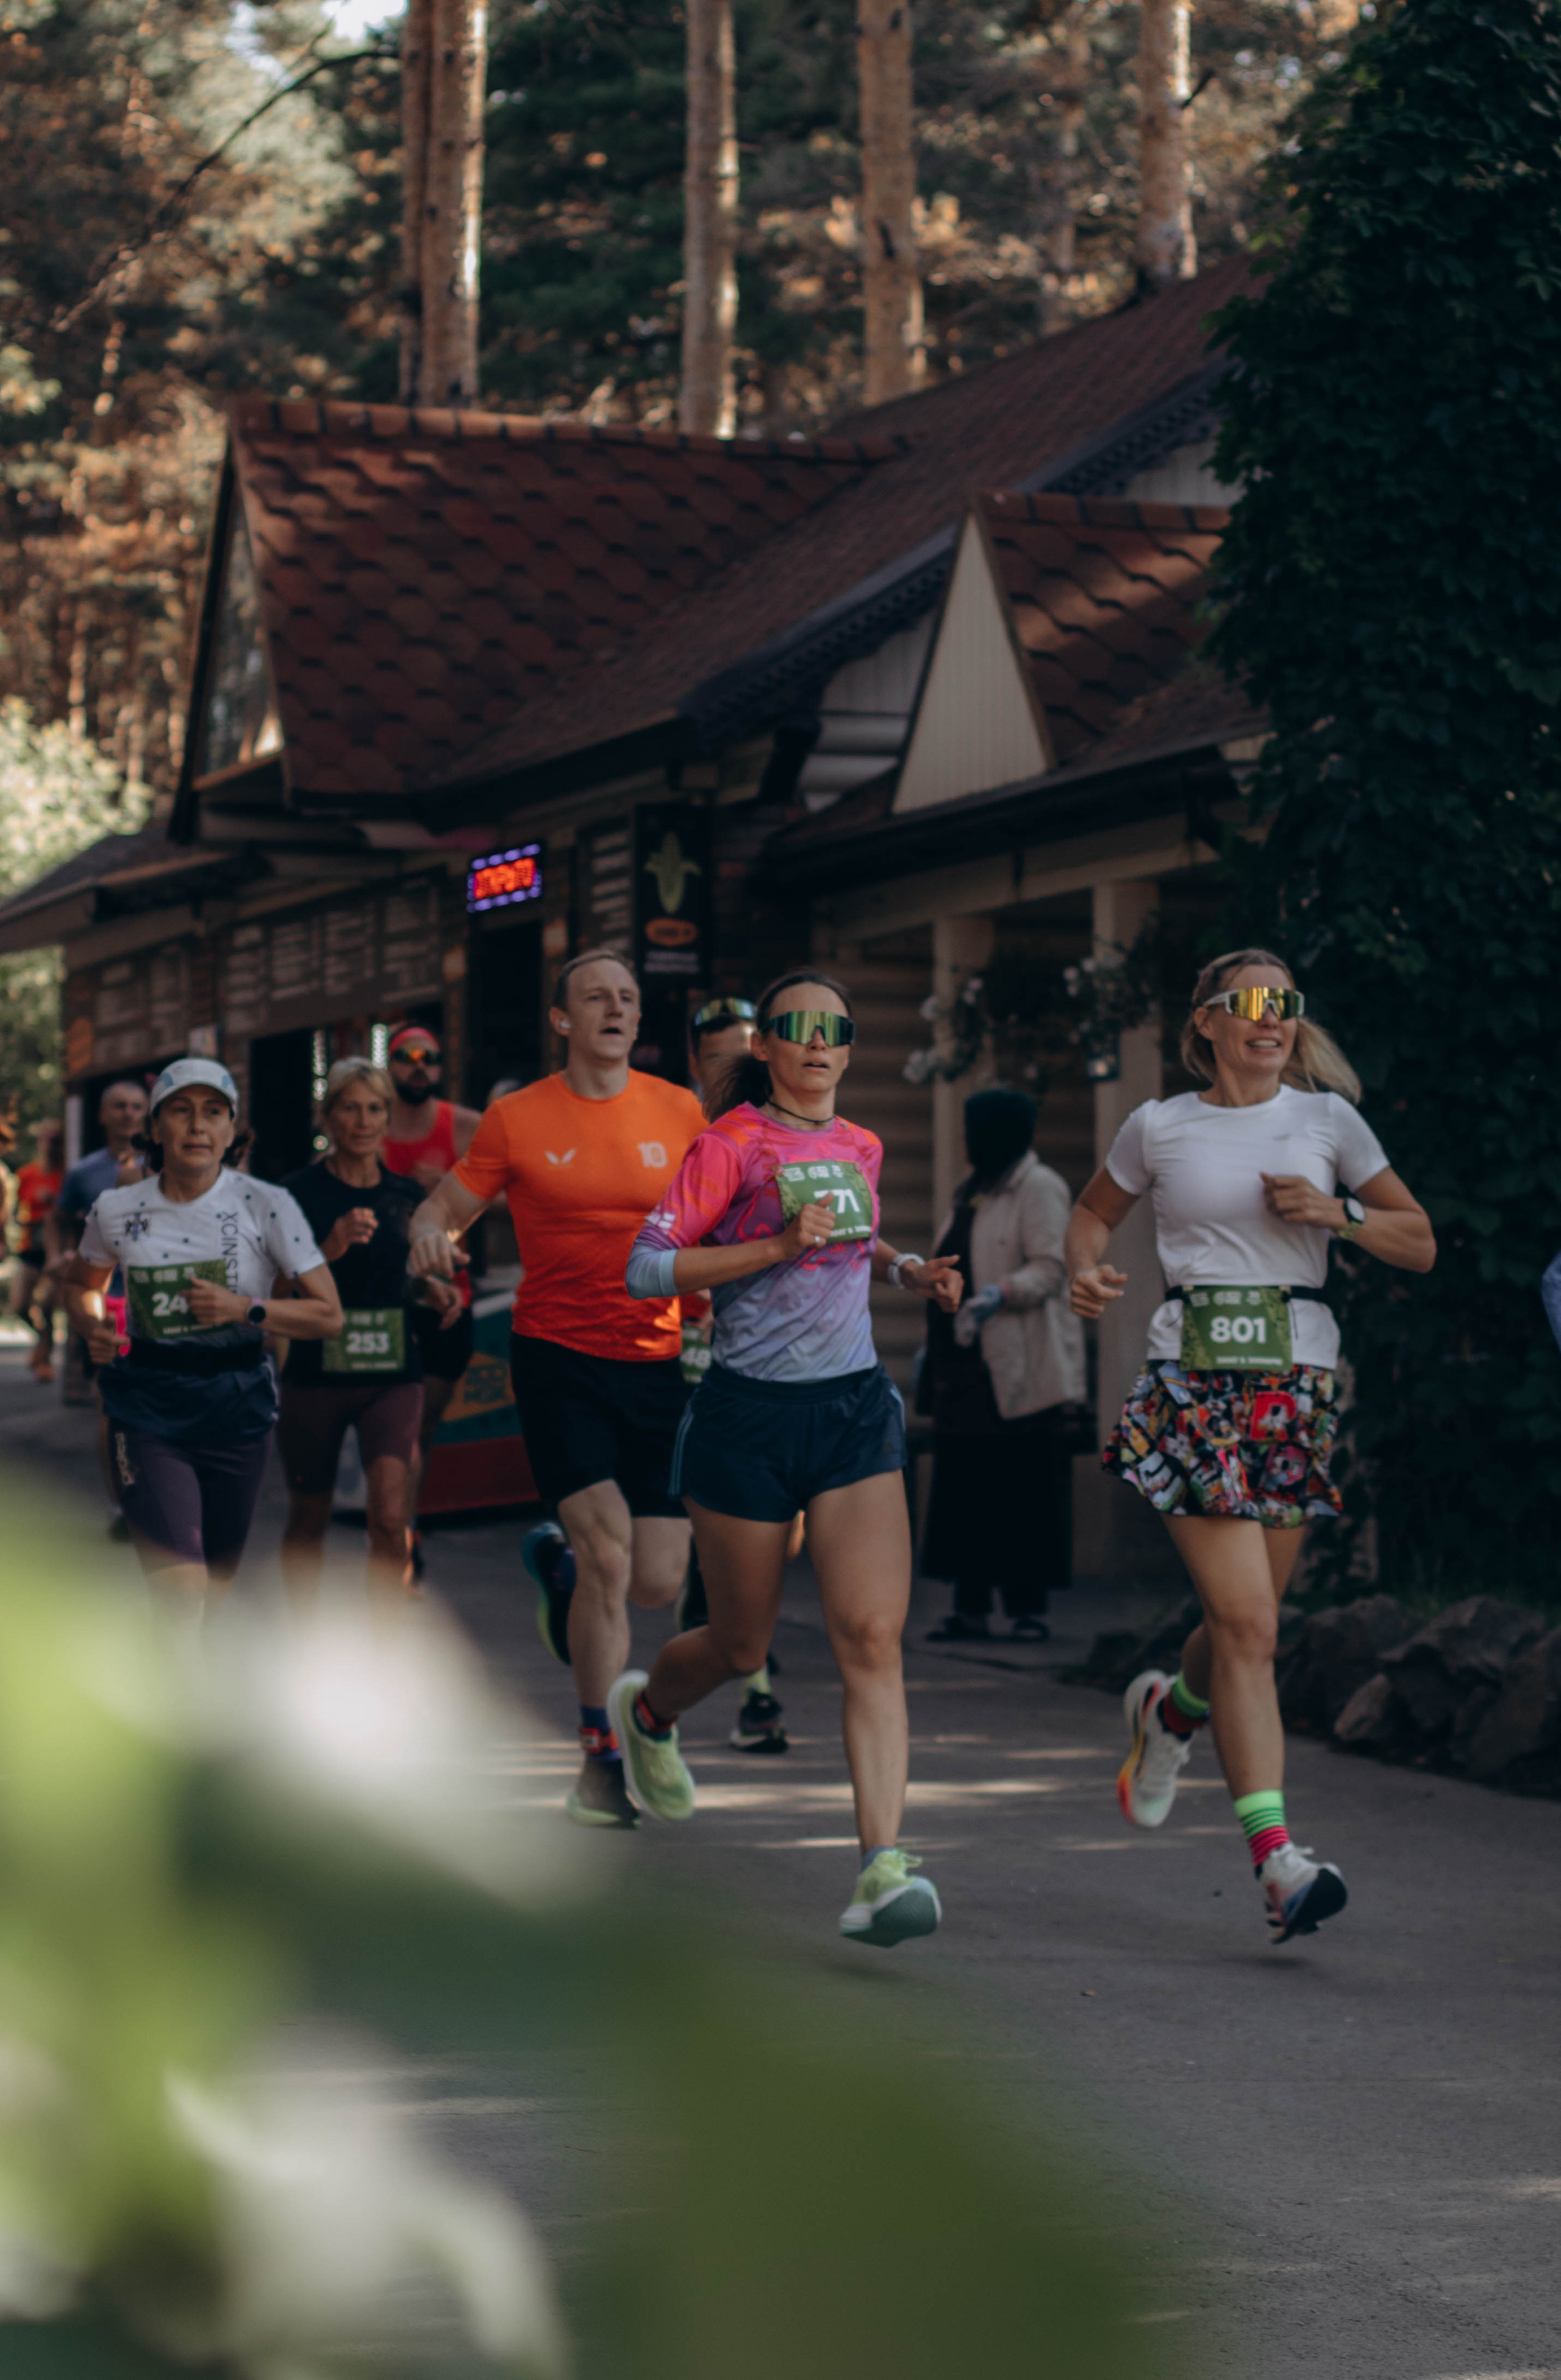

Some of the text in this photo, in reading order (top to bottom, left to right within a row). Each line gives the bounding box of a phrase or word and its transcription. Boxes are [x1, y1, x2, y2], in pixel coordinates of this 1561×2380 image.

[637, 1142, 666, 1167] 10
[221, 1211, 238, 1292] XCINSTI
[152, 1292, 188, 1316] 24
[1210, 1316, 1266, 1344] 801
[346, 1332, 389, 1353] 253
[680, 1347, 711, 1369] 48
